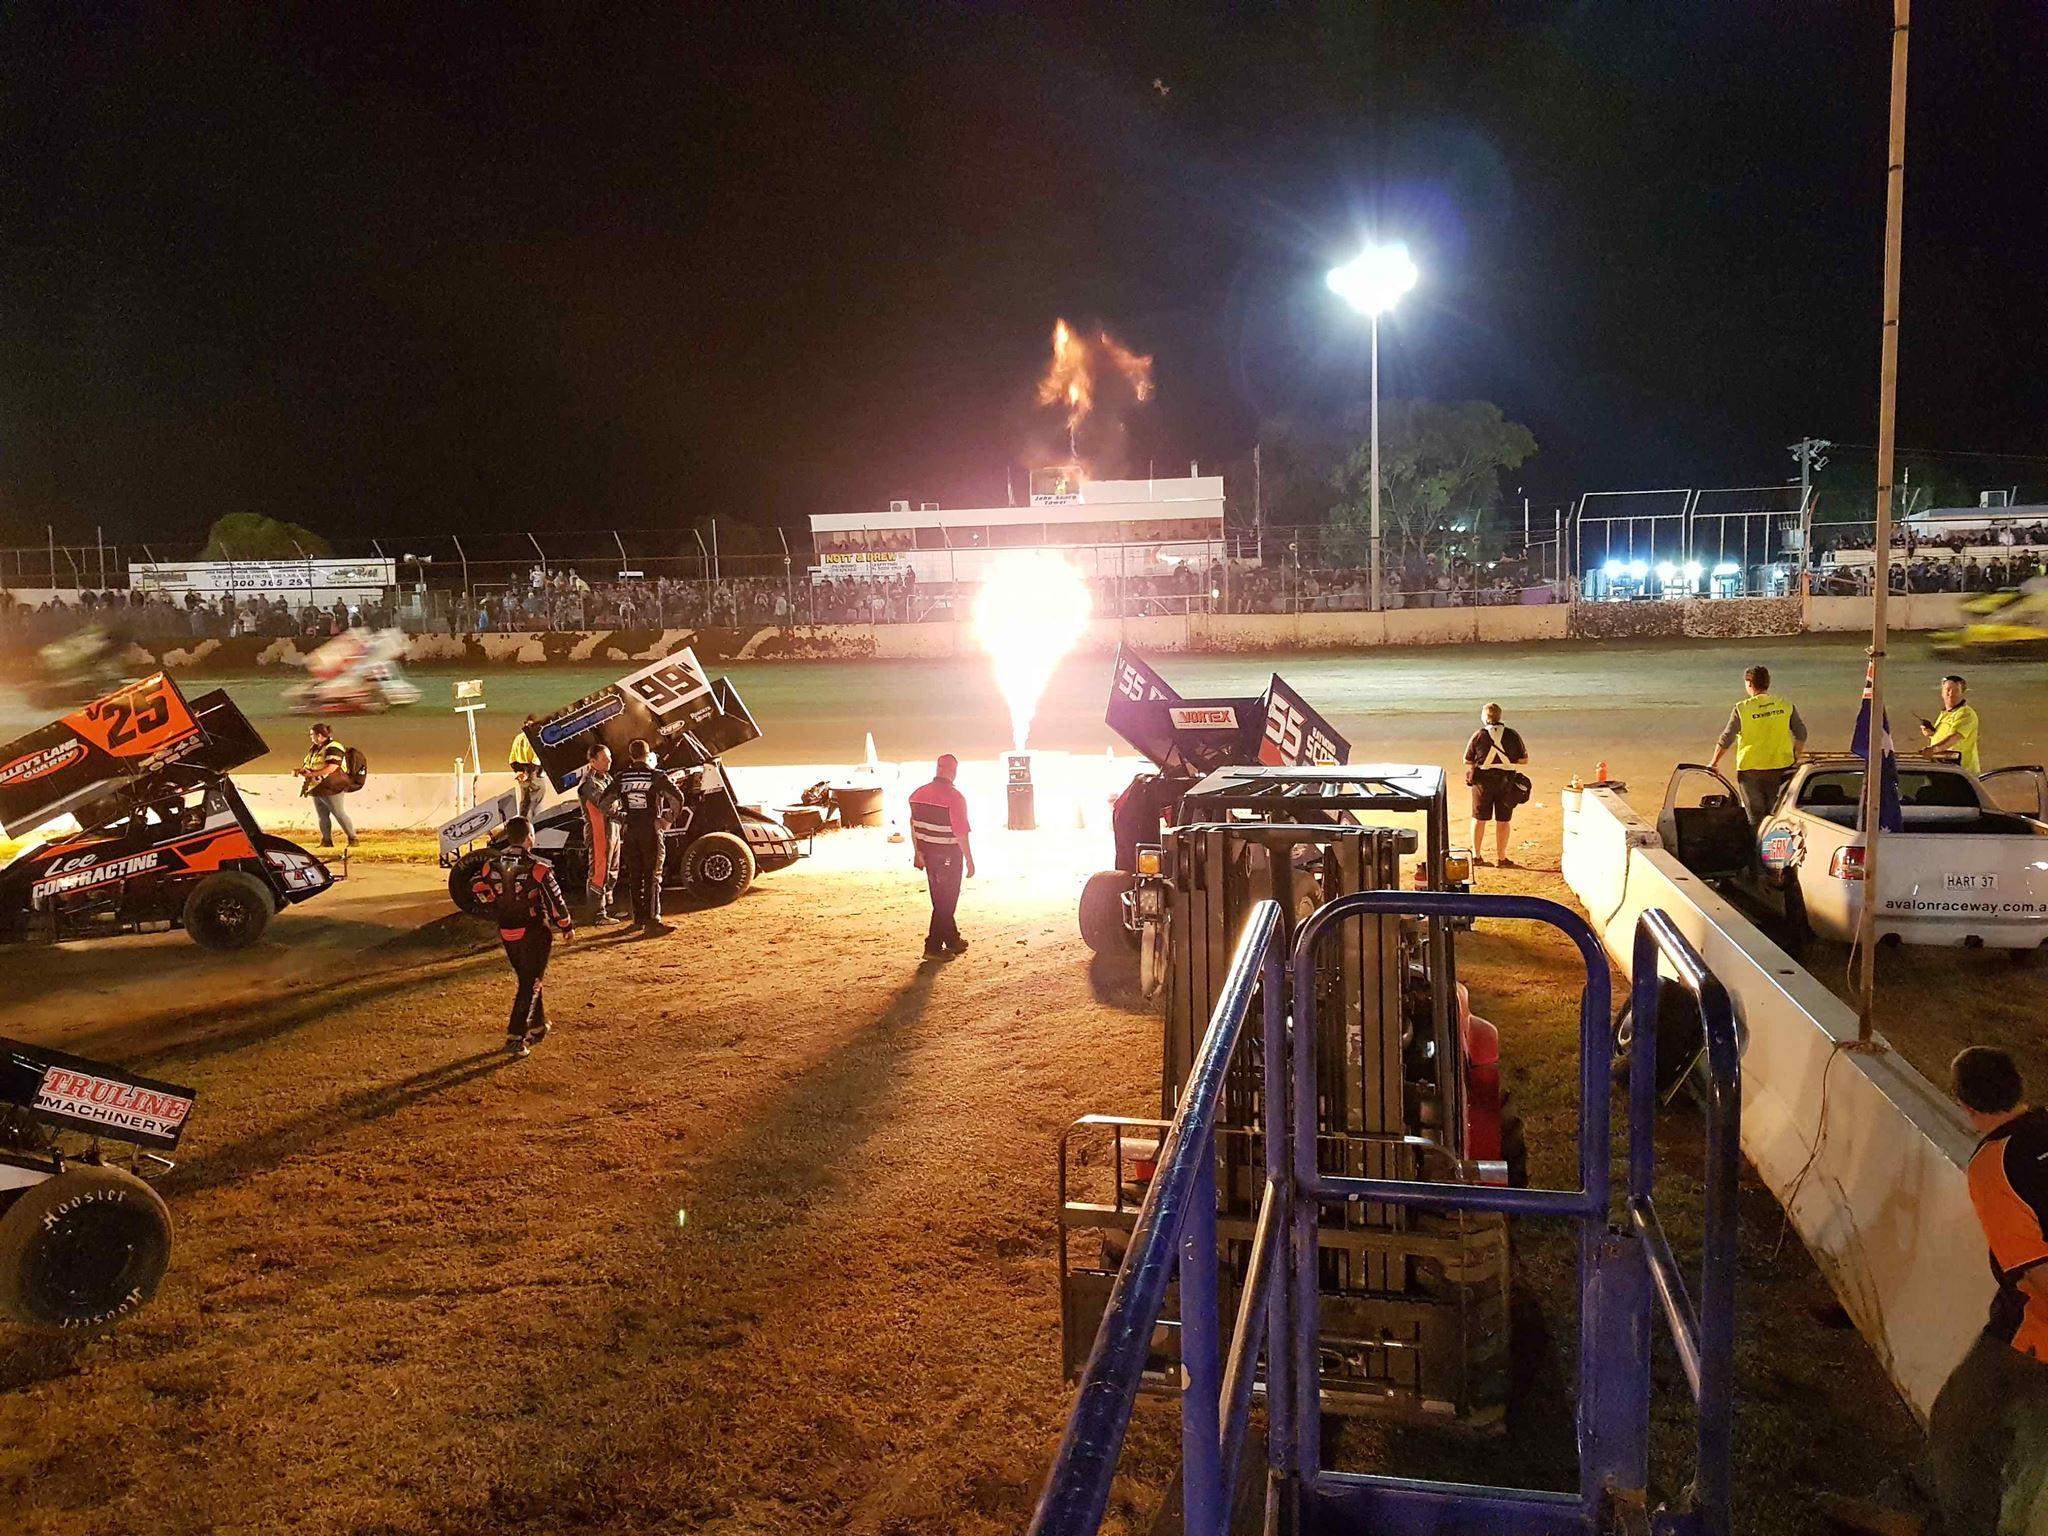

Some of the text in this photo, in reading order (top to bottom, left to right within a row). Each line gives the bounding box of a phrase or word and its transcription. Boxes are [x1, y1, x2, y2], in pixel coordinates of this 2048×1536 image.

[825, 553, 853, 564] NOTT
[259, 579, 283, 587] 365
[1265, 691, 1307, 758] 55
[32, 853, 158, 899] CONTRACTING
[44, 853, 98, 878] Lee
[1947, 876, 1994, 887] HART 37
[42, 1067, 191, 1122] TRULINE
[42, 1096, 172, 1134] MACHINERY
